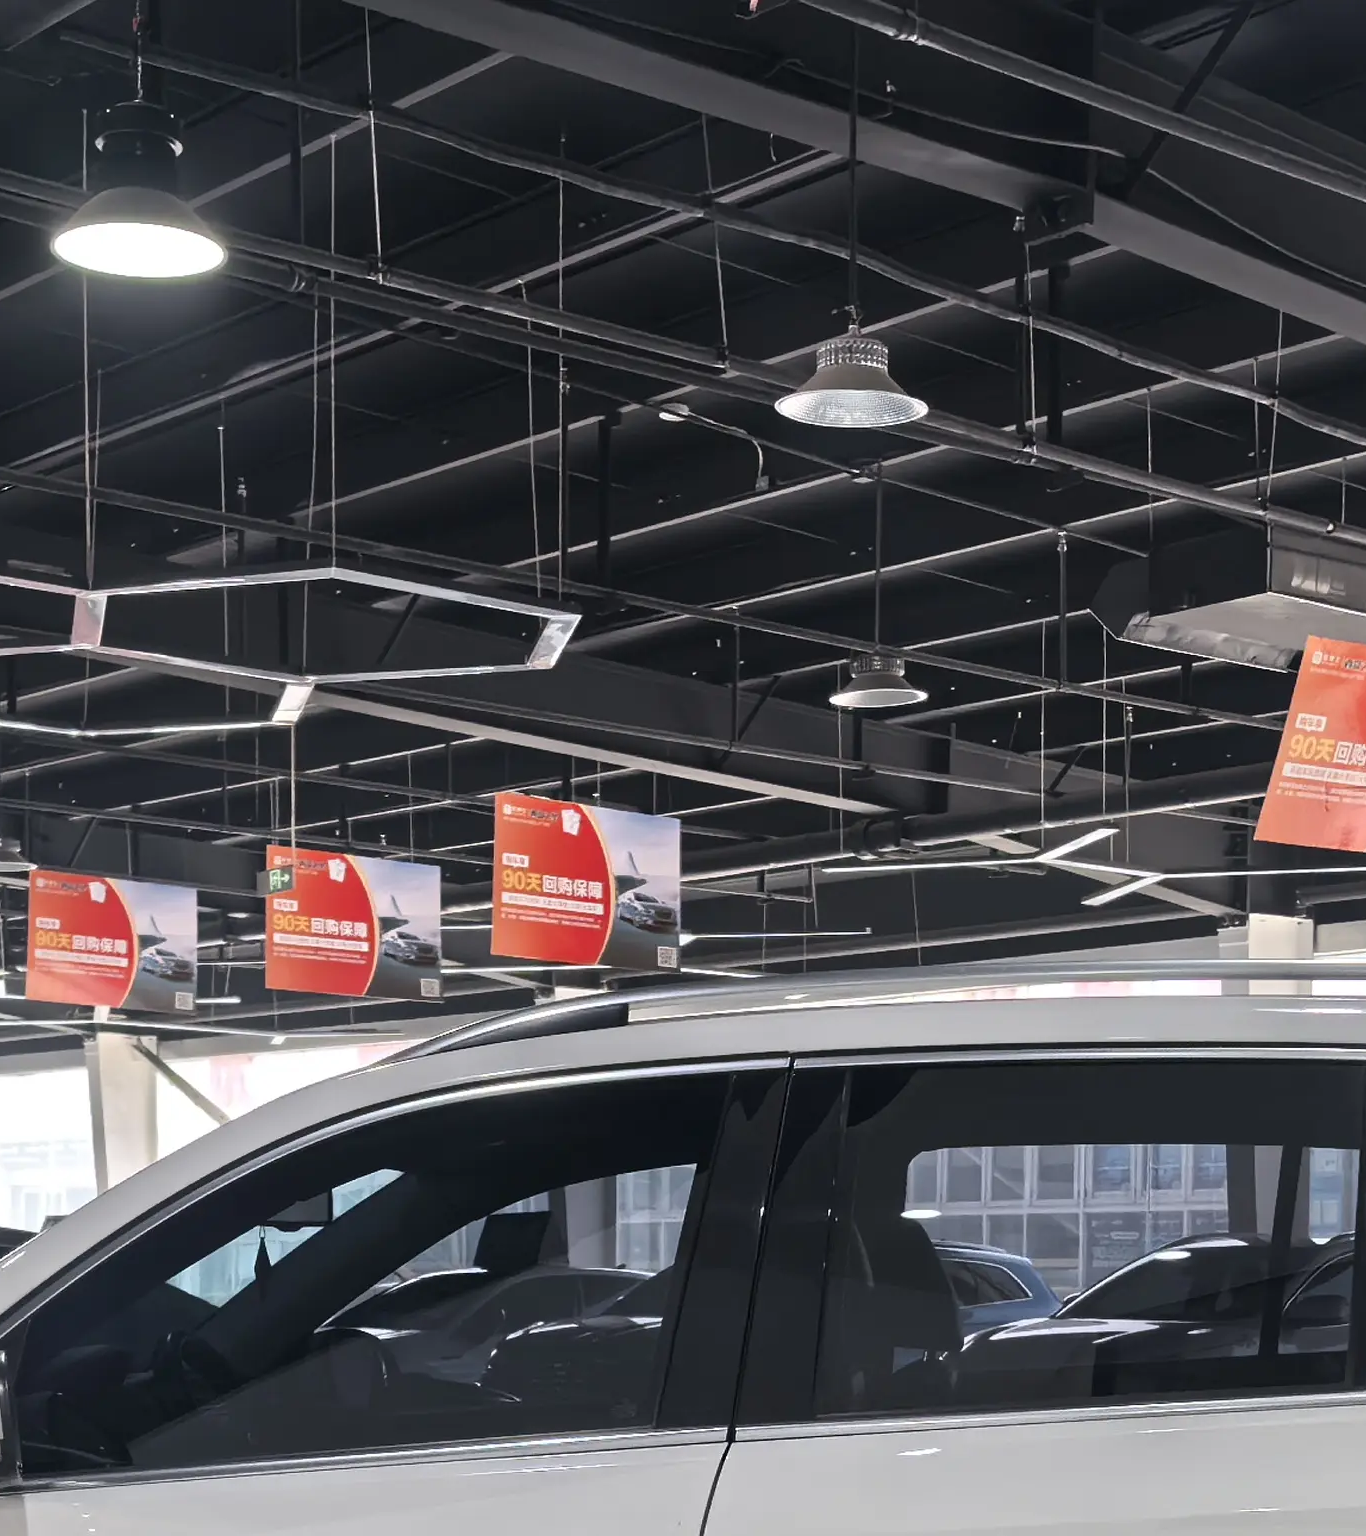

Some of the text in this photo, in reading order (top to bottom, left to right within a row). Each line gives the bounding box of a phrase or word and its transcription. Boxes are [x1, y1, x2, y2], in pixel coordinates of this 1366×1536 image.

[501, 869, 603, 900] 90天回购保障
[272, 913, 368, 938] 90天回购保障
